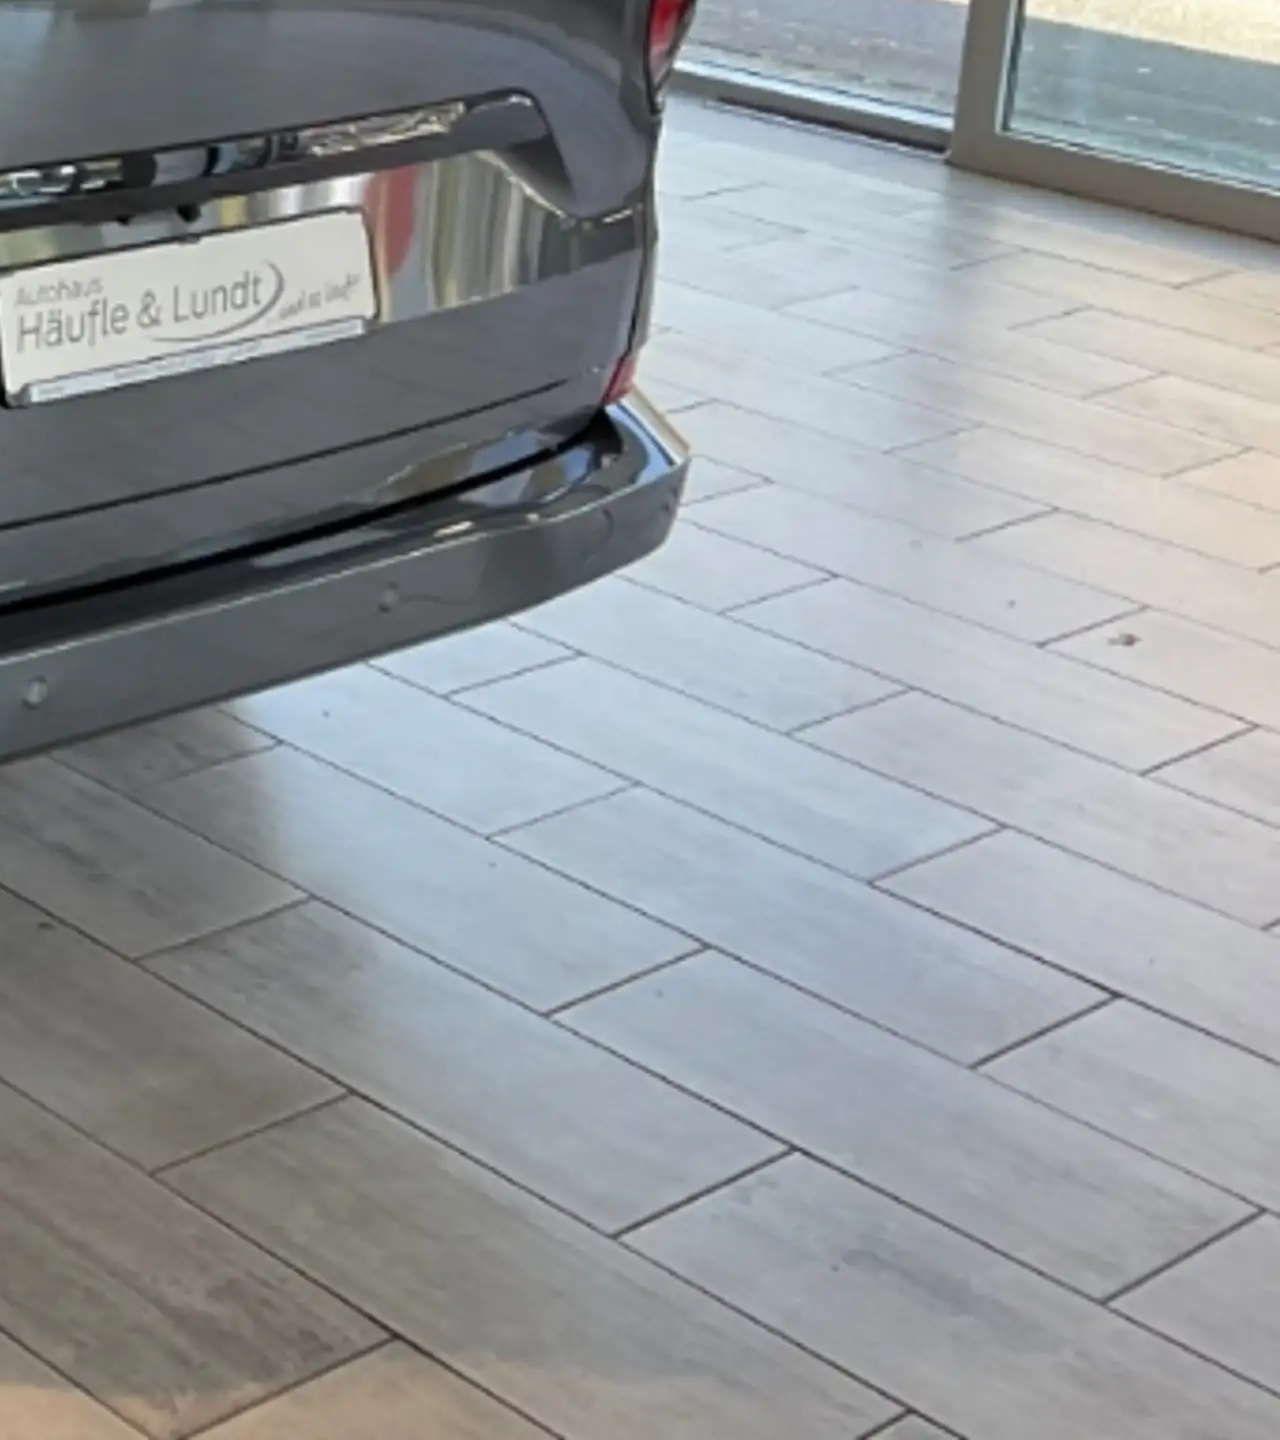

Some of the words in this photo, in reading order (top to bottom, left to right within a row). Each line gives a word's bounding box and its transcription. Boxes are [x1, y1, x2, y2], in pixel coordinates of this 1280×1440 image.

[16, 296, 130, 354] Häufle
[136, 287, 162, 330] &
[173, 268, 263, 325] Lundt
